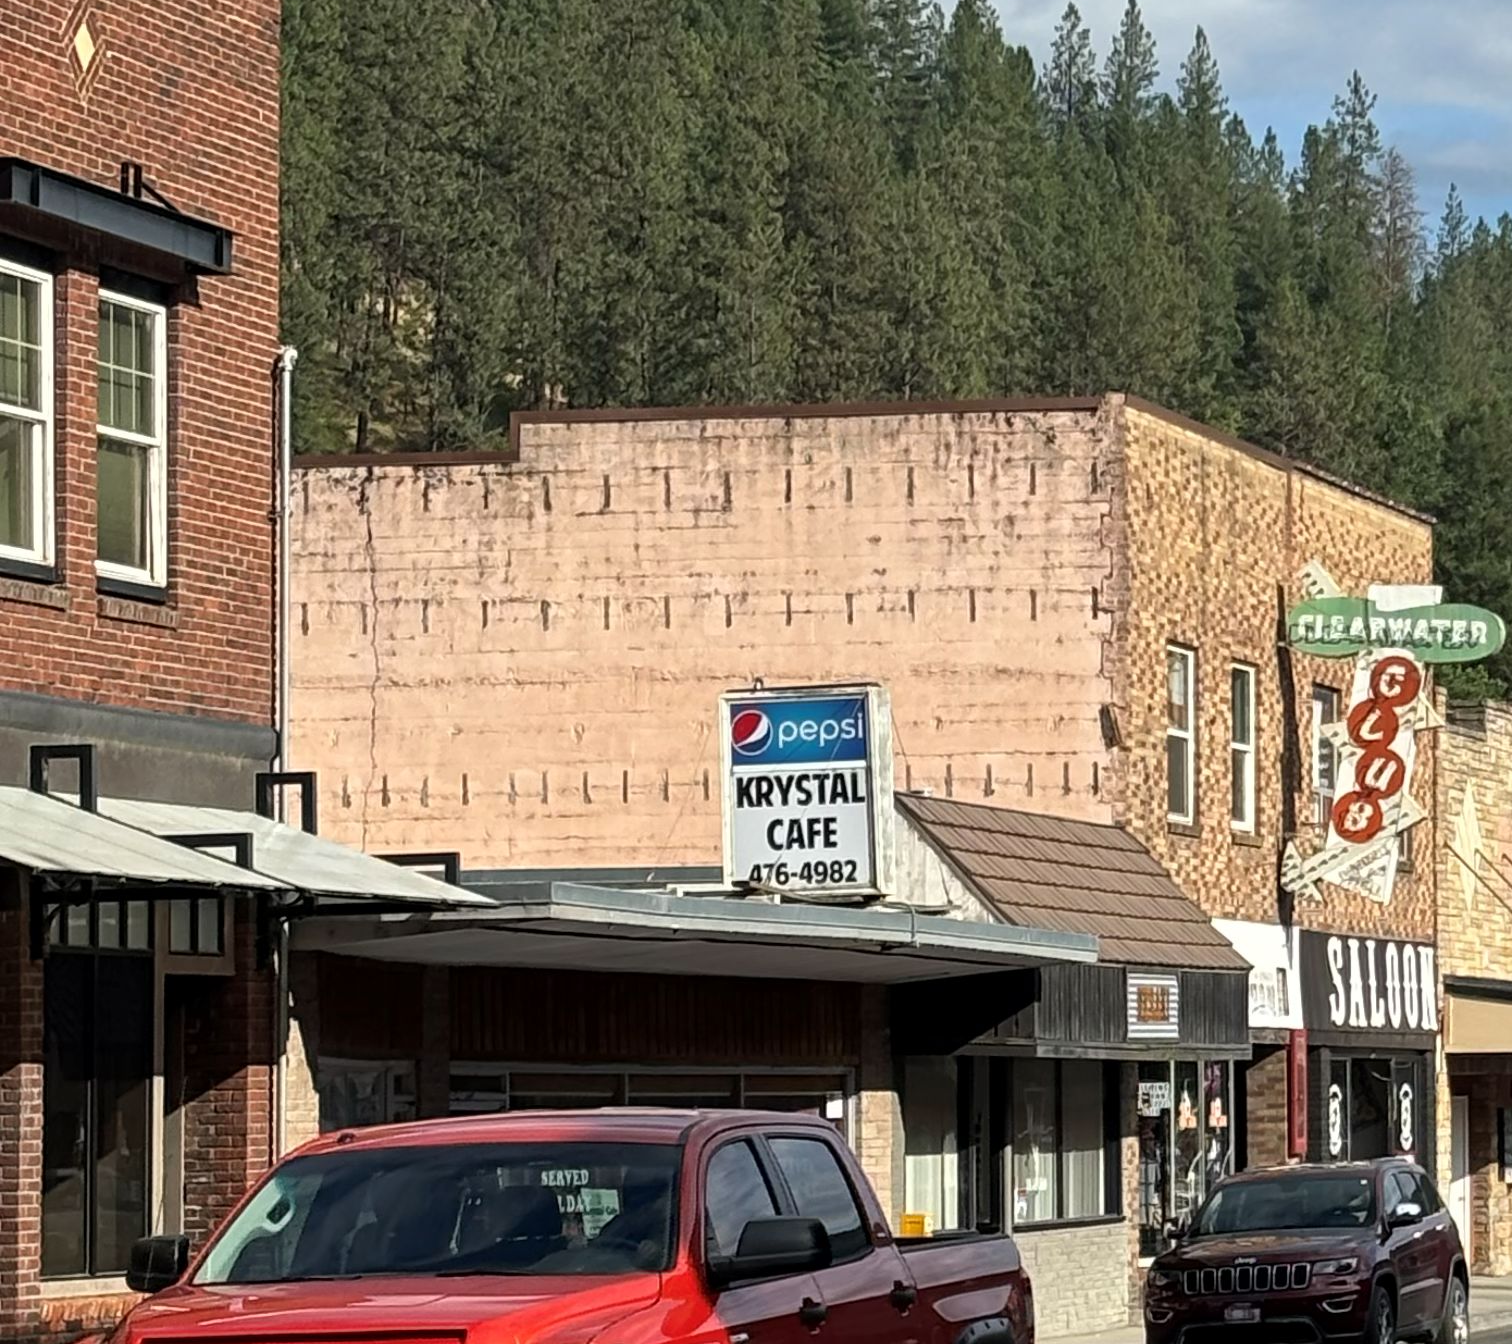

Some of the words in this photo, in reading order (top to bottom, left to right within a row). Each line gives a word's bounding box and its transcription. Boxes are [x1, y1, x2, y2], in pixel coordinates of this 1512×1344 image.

[1298, 613, 1488, 646] CLEARWATER
[778, 712, 863, 749] pepsi
[1343, 665, 1407, 832] CLUB
[735, 771, 866, 809] KRYSTAL
[766, 816, 838, 851] CAFE
[748, 859, 858, 886] 476-4982
[1327, 936, 1438, 1031] SALOON
[541, 1169, 589, 1186] SERVED
